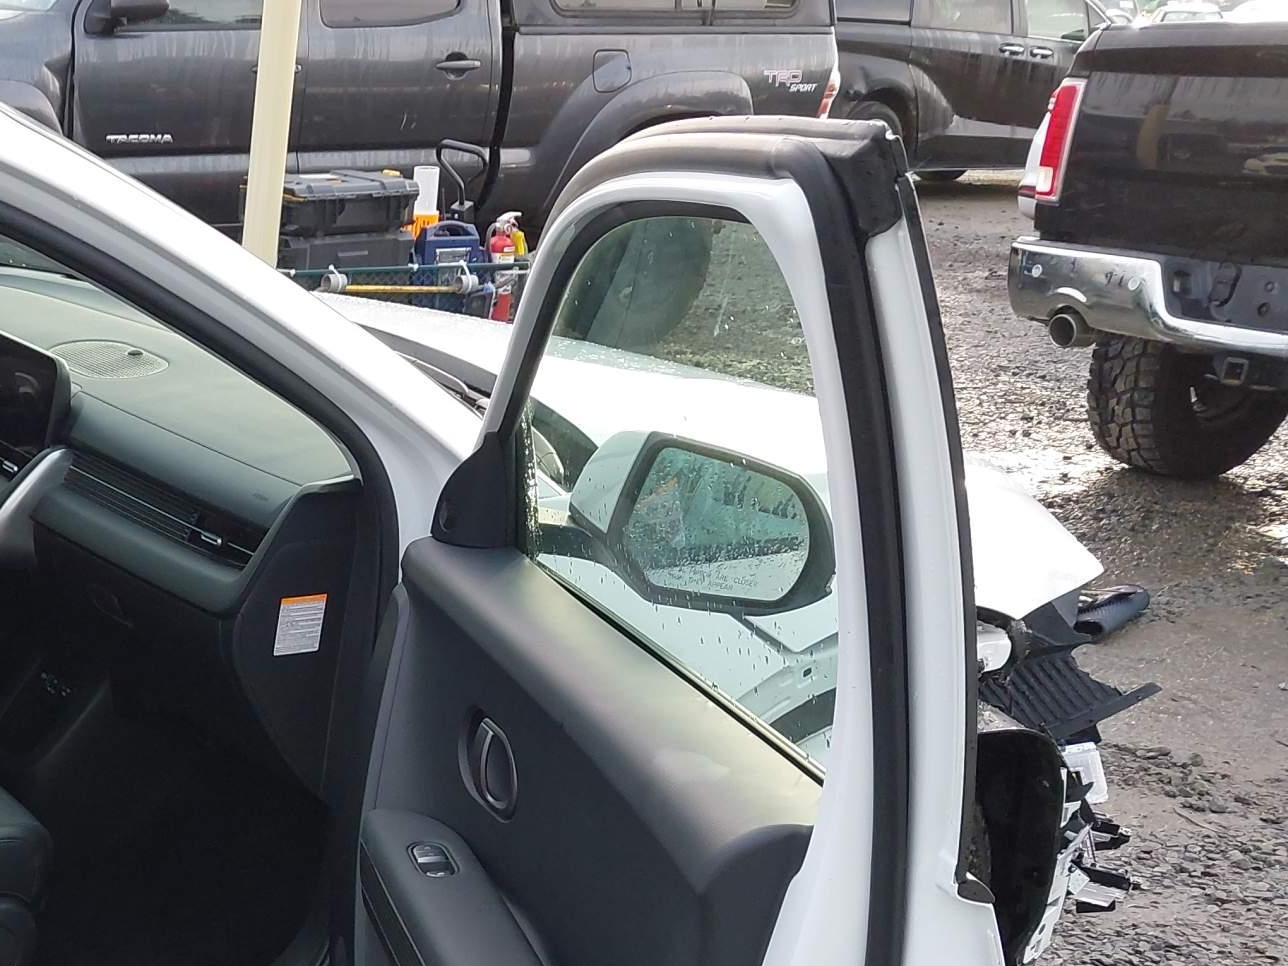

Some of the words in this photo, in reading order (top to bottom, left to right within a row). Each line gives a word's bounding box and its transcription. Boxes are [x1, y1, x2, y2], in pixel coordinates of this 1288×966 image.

[763, 69, 803, 87] TRD
[789, 83, 818, 92] SPORT
[105, 134, 173, 144] TACOMA
